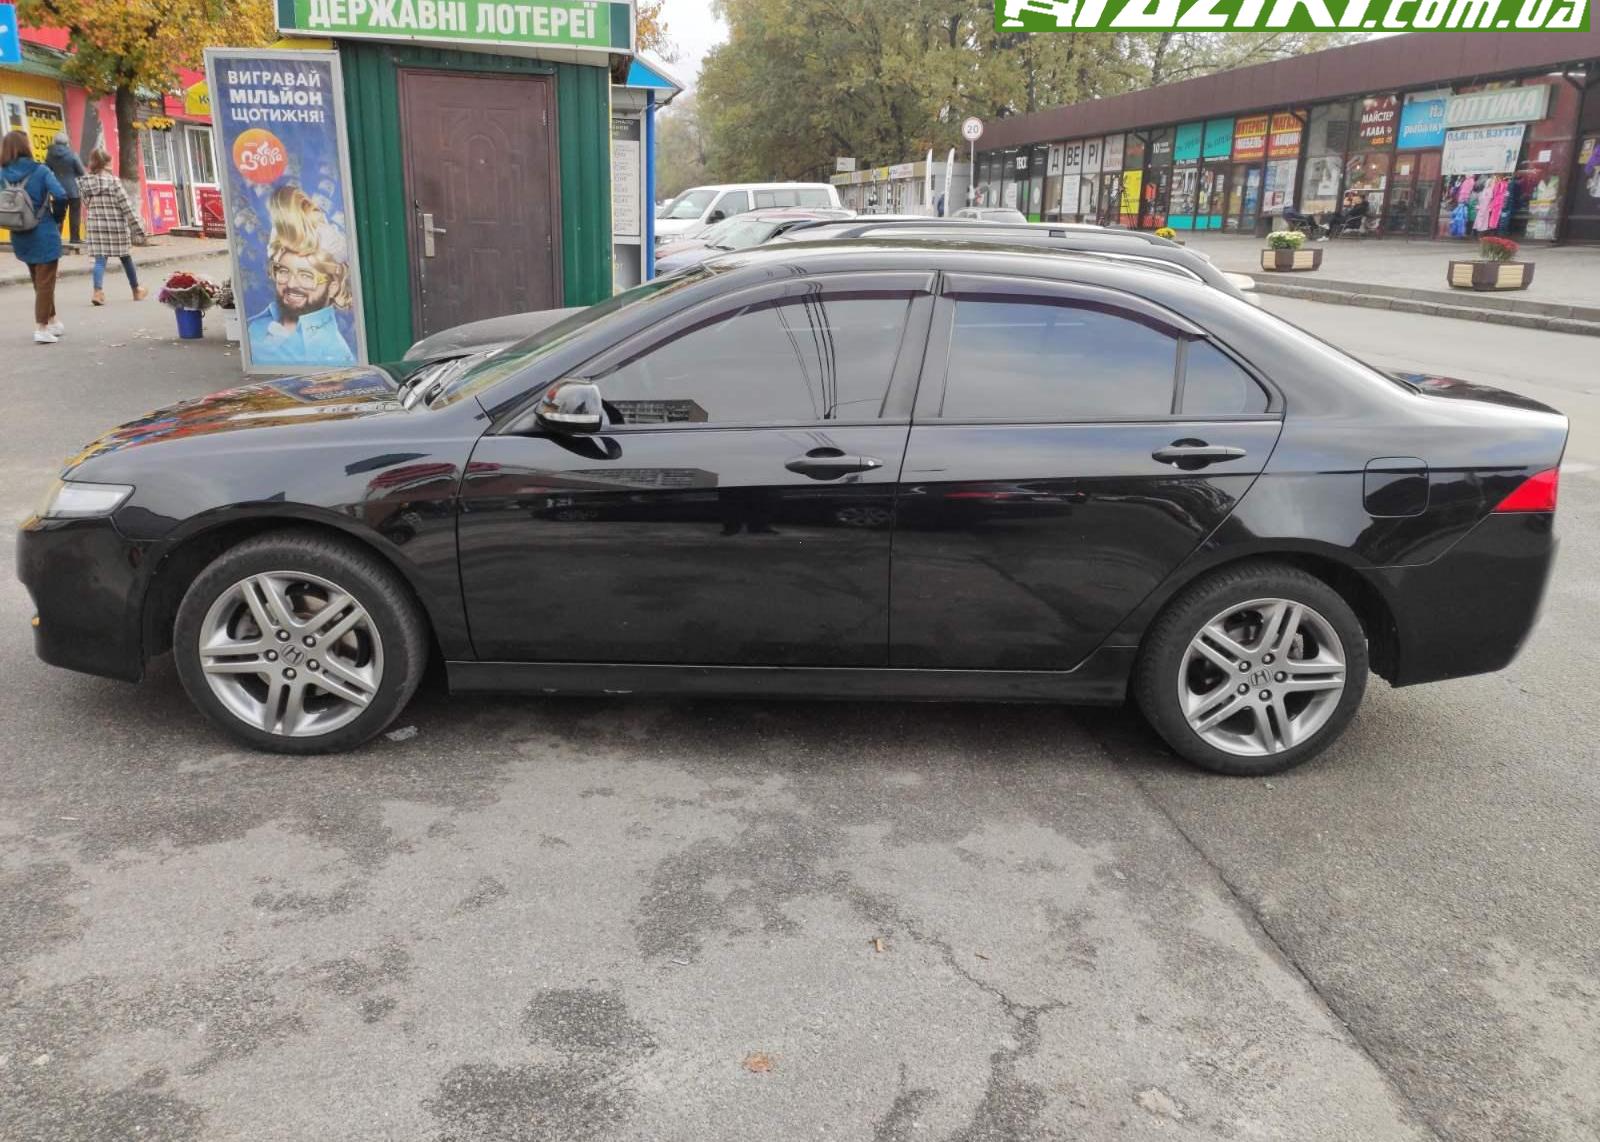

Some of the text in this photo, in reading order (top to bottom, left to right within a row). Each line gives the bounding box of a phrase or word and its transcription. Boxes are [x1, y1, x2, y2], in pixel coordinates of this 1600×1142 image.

[308, 0, 598, 39] ДЕРЖАВНІ ЛОТЕРЕЇ
[228, 70, 321, 88] ВИГРАВАЙ
[229, 87, 323, 106] МІЛЬЙОН
[231, 108, 325, 123] ЩОТИЖНЯ!
[1448, 89, 1537, 124] ОПТИКА
[1362, 110, 1394, 124] МАЙСТЕР
[967, 124, 979, 134] 20
